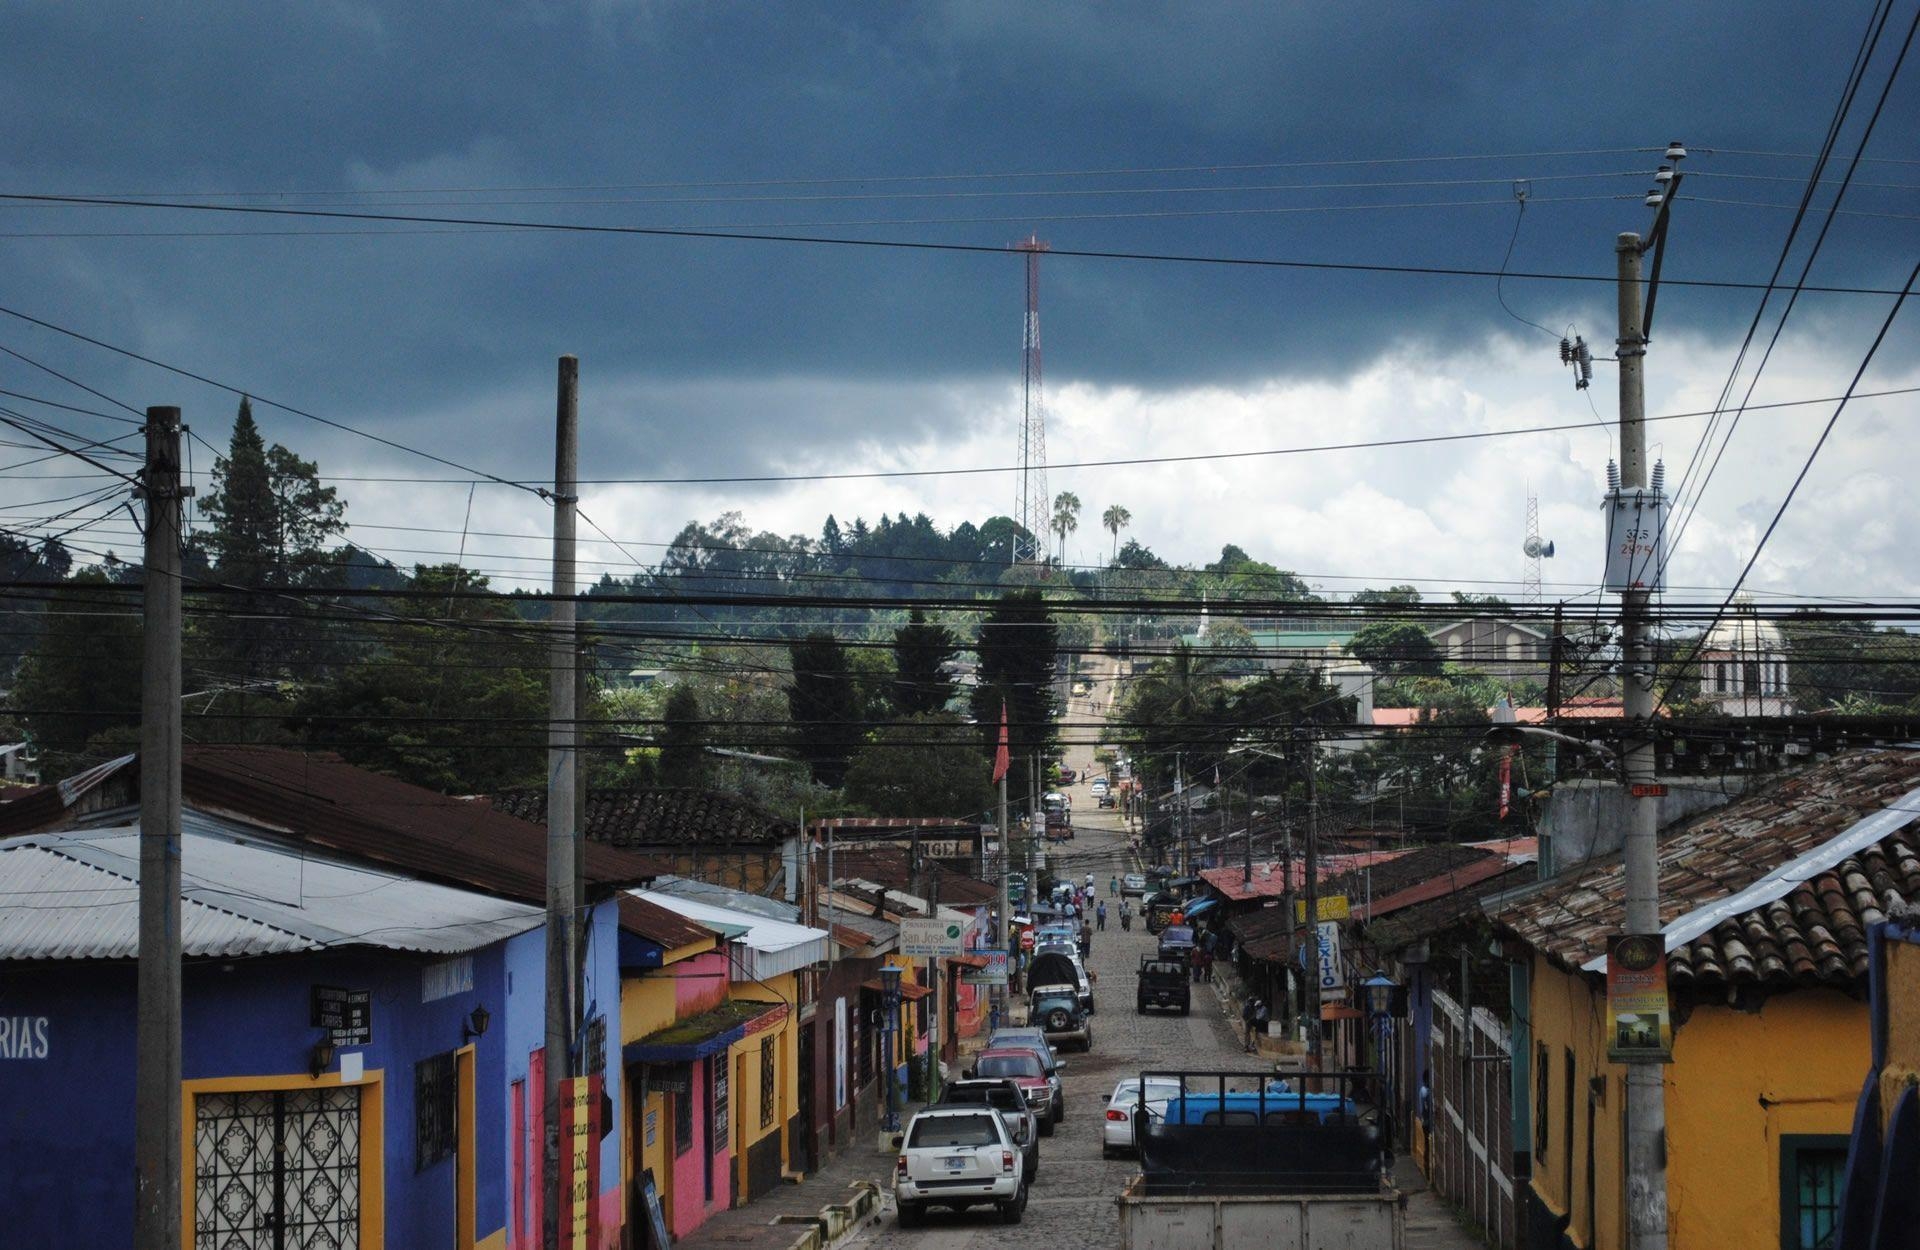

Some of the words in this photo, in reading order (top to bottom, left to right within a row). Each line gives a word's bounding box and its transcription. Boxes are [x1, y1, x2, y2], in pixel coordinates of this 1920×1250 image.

[902, 930, 920, 945] San
[921, 930, 945, 945] Jose
[0, 1016, 49, 1059] RIAS
